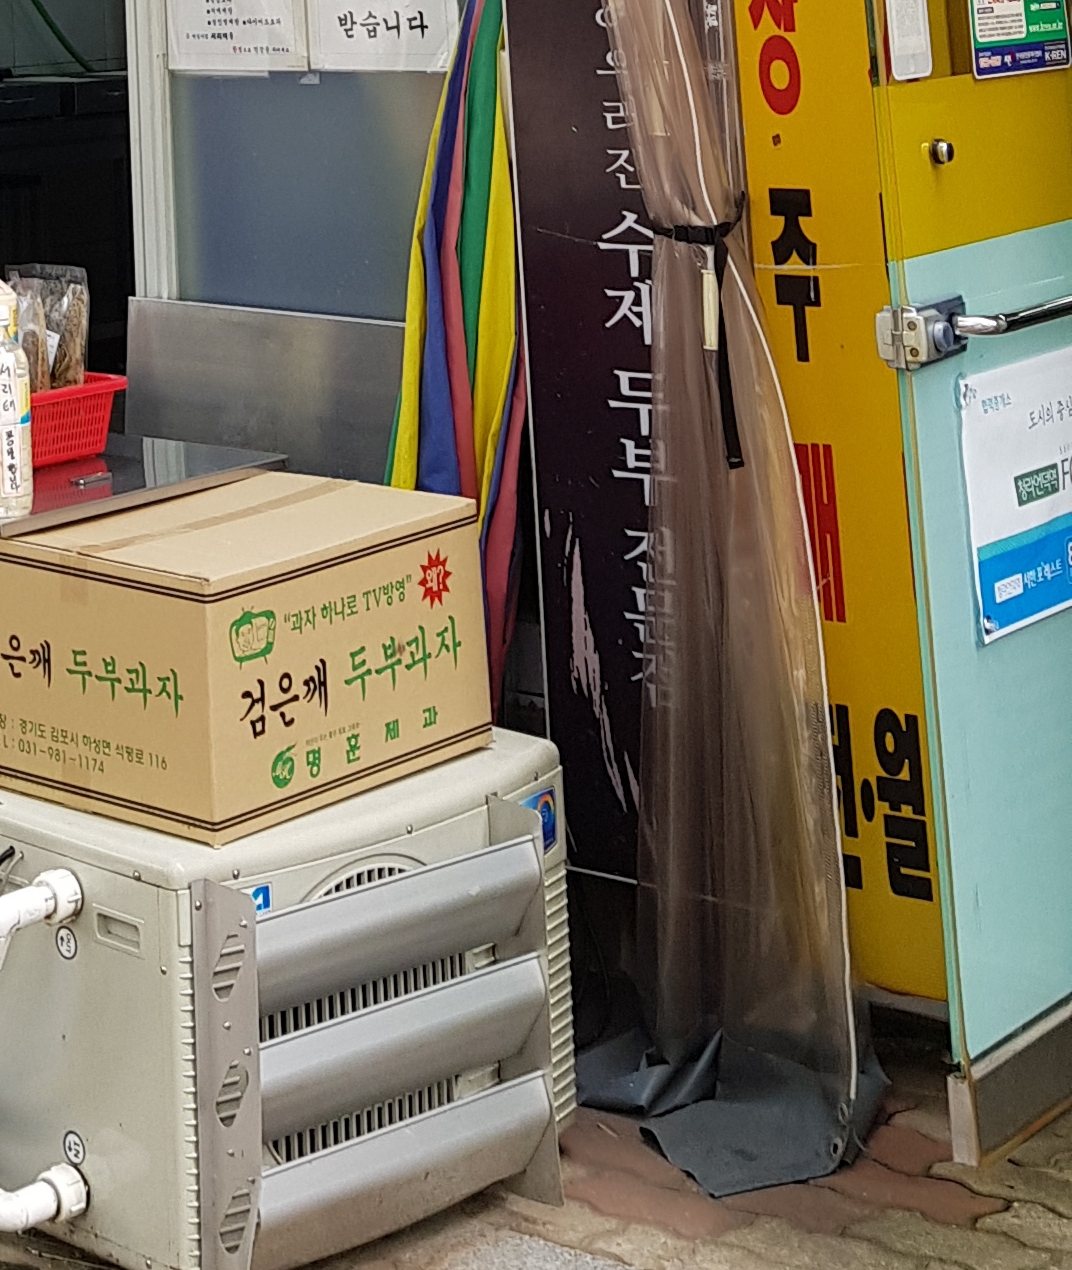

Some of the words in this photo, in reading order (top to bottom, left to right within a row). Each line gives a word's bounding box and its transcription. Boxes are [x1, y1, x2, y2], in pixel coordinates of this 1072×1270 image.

[337, 10, 429, 40] 받습니다
[1028, 399, 1056, 431] 도시의
[320, 594, 359, 626] 하나로
[425, 564, 445, 593] 왜?
[65, 648, 185, 719] 두부과자
[239, 657, 329, 740] 검은깨
[344, 614, 462, 702] 두부과자
[19, 718, 46, 740] 경기도
[50, 726, 78, 748] 김포시
[82, 734, 112, 757] 하성면
[148, 751, 168, 771] 116
